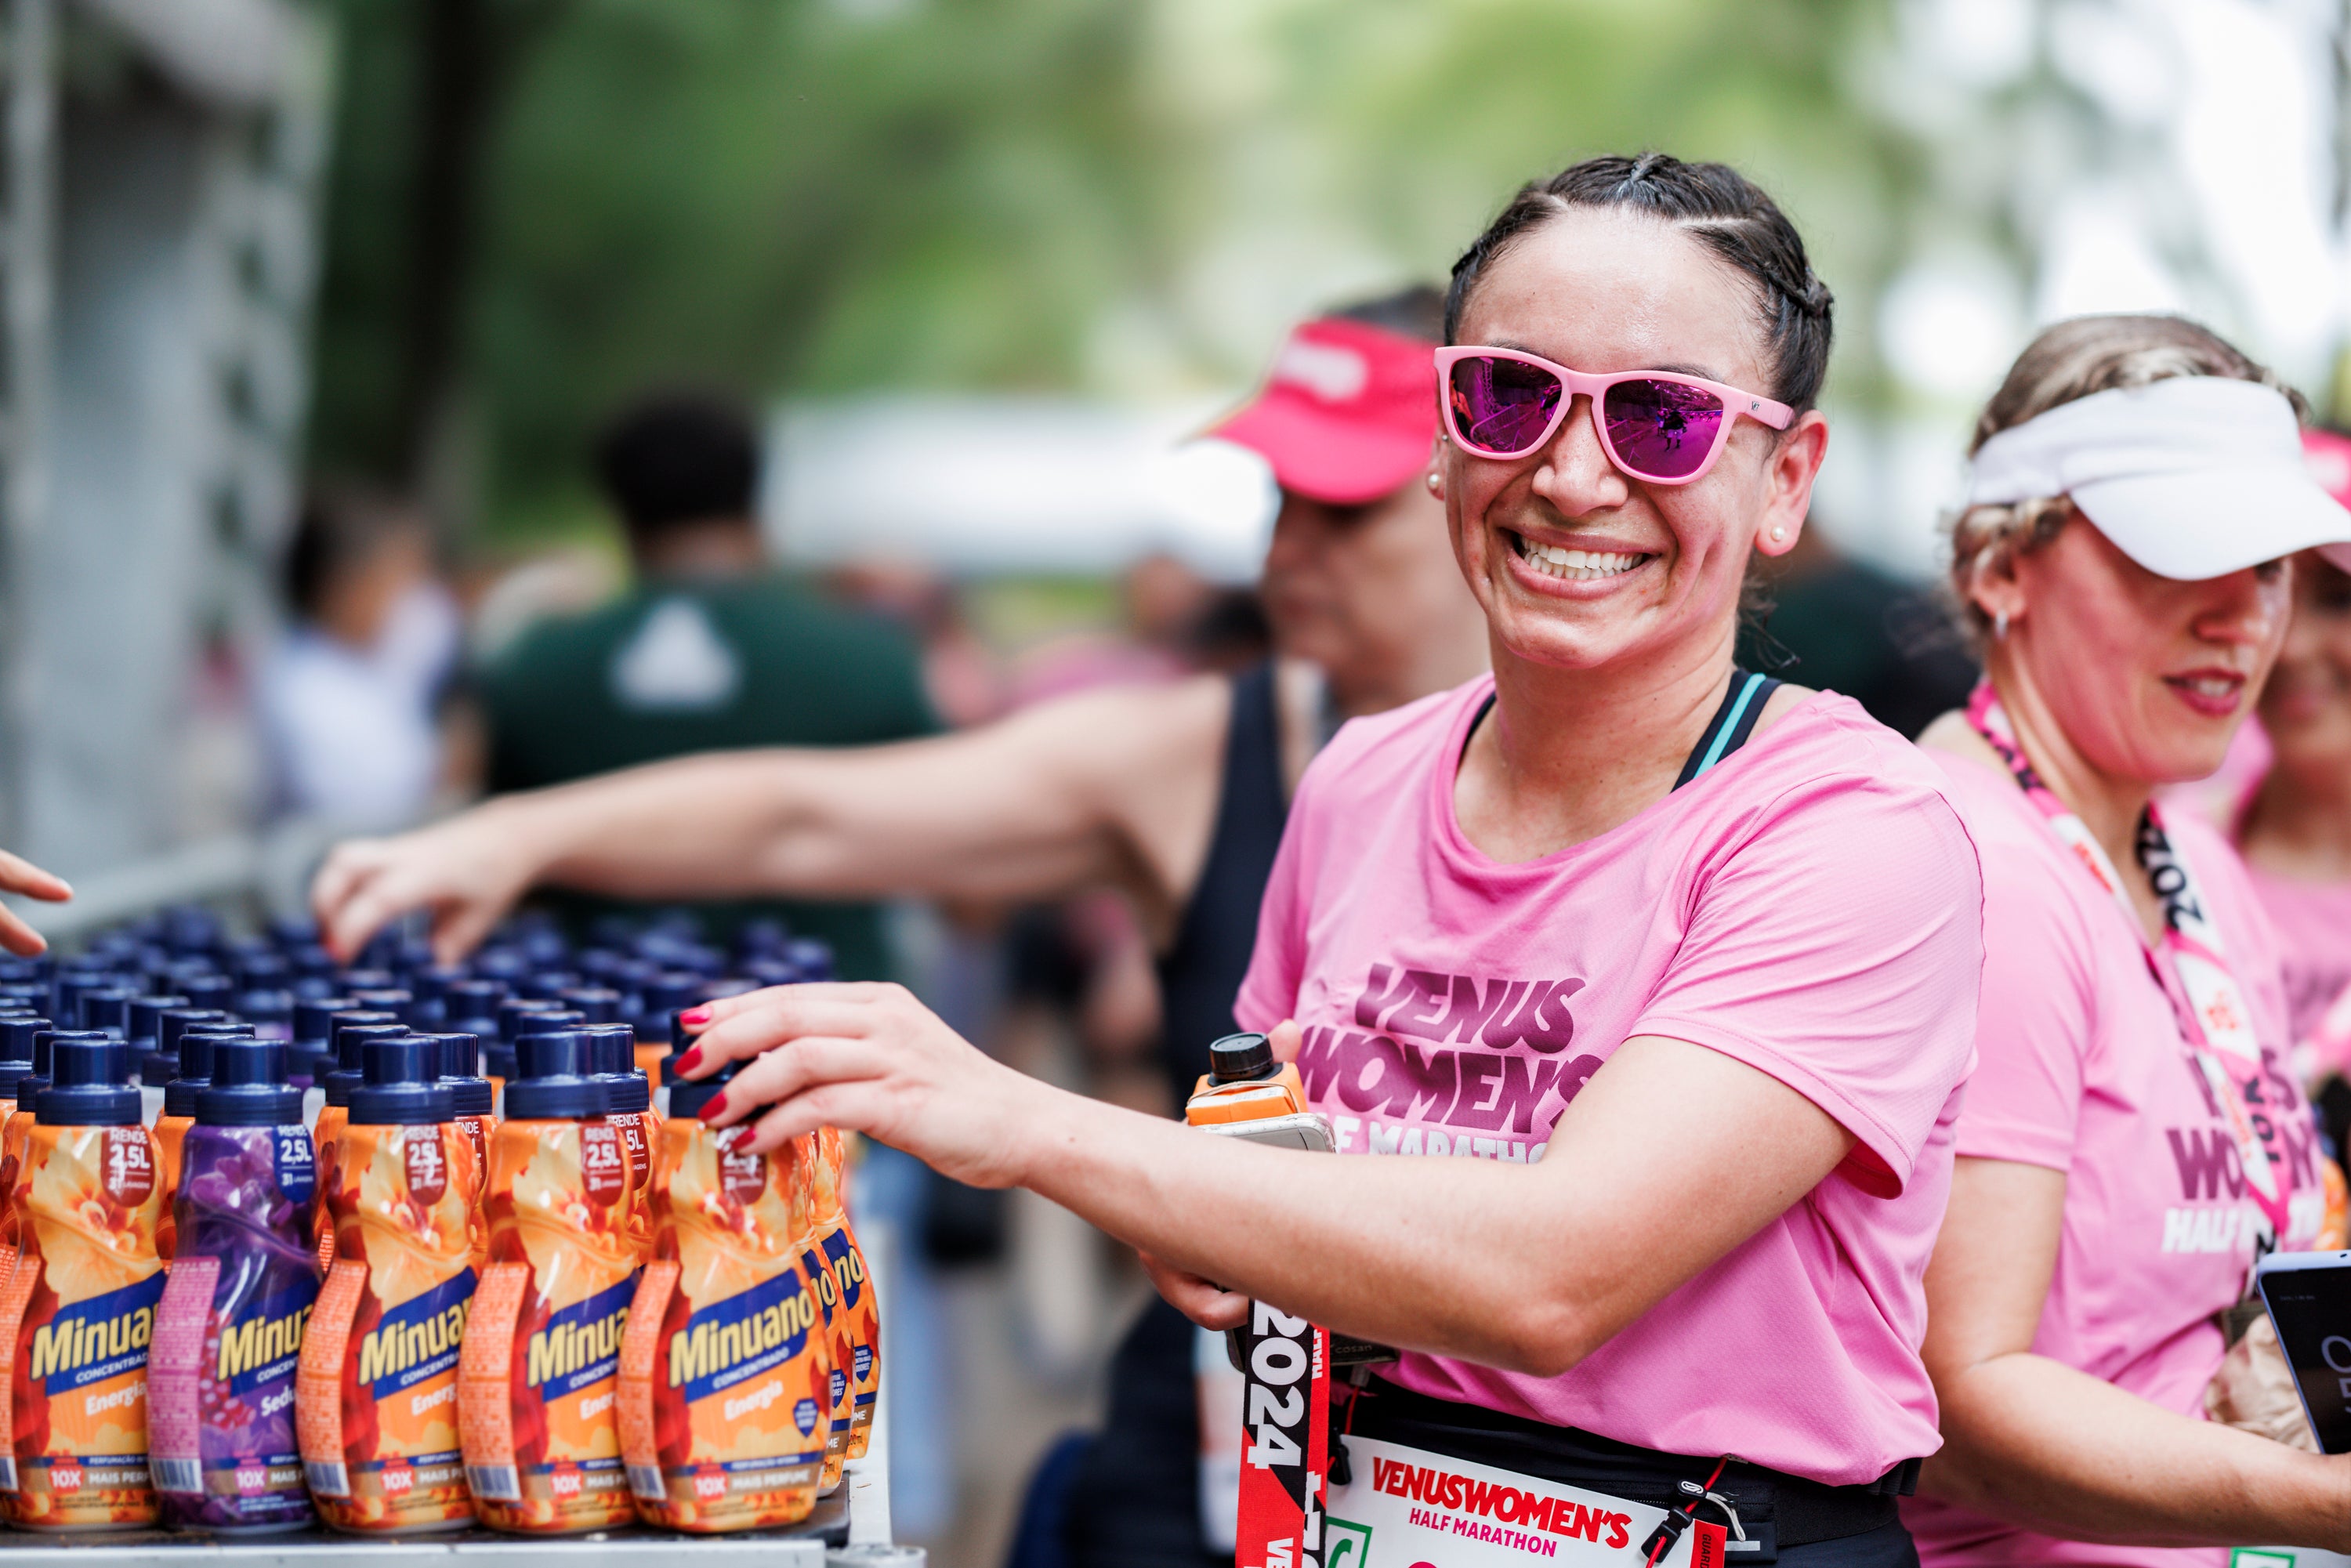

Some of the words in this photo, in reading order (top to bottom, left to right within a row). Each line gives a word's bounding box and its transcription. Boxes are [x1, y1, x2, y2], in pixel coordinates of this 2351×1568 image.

[1355, 963, 1586, 1054] VENUS
[1298, 1026, 1605, 1134] WOMEN'S
[110, 1127, 147, 1144] RENDE
[456, 1121, 480, 1134] NDE
[626, 1129, 645, 1151] 5L
[109, 1143, 150, 1169] 2,5L
[281, 1139, 312, 1165] 2,5L
[587, 1143, 621, 1169] 2,5L
[359, 1295, 473, 1386] Minua
[668, 1287, 817, 1389] Minuano
[1247, 1298, 1308, 1470] 2024
[51, 1469, 82, 1488] 10X
[89, 1472, 120, 1484] MAIS
[237, 1470, 265, 1488] 10X
[382, 1470, 413, 1490] 10X
[418, 1468, 450, 1484] MAIS
[552, 1474, 581, 1494] 10X
[694, 1476, 726, 1497] 10X
[1372, 1456, 1632, 1549] VENUSWOMEN'S
[1409, 1507, 1451, 1531] HALF
[1452, 1517, 1557, 1558] MARATHON
